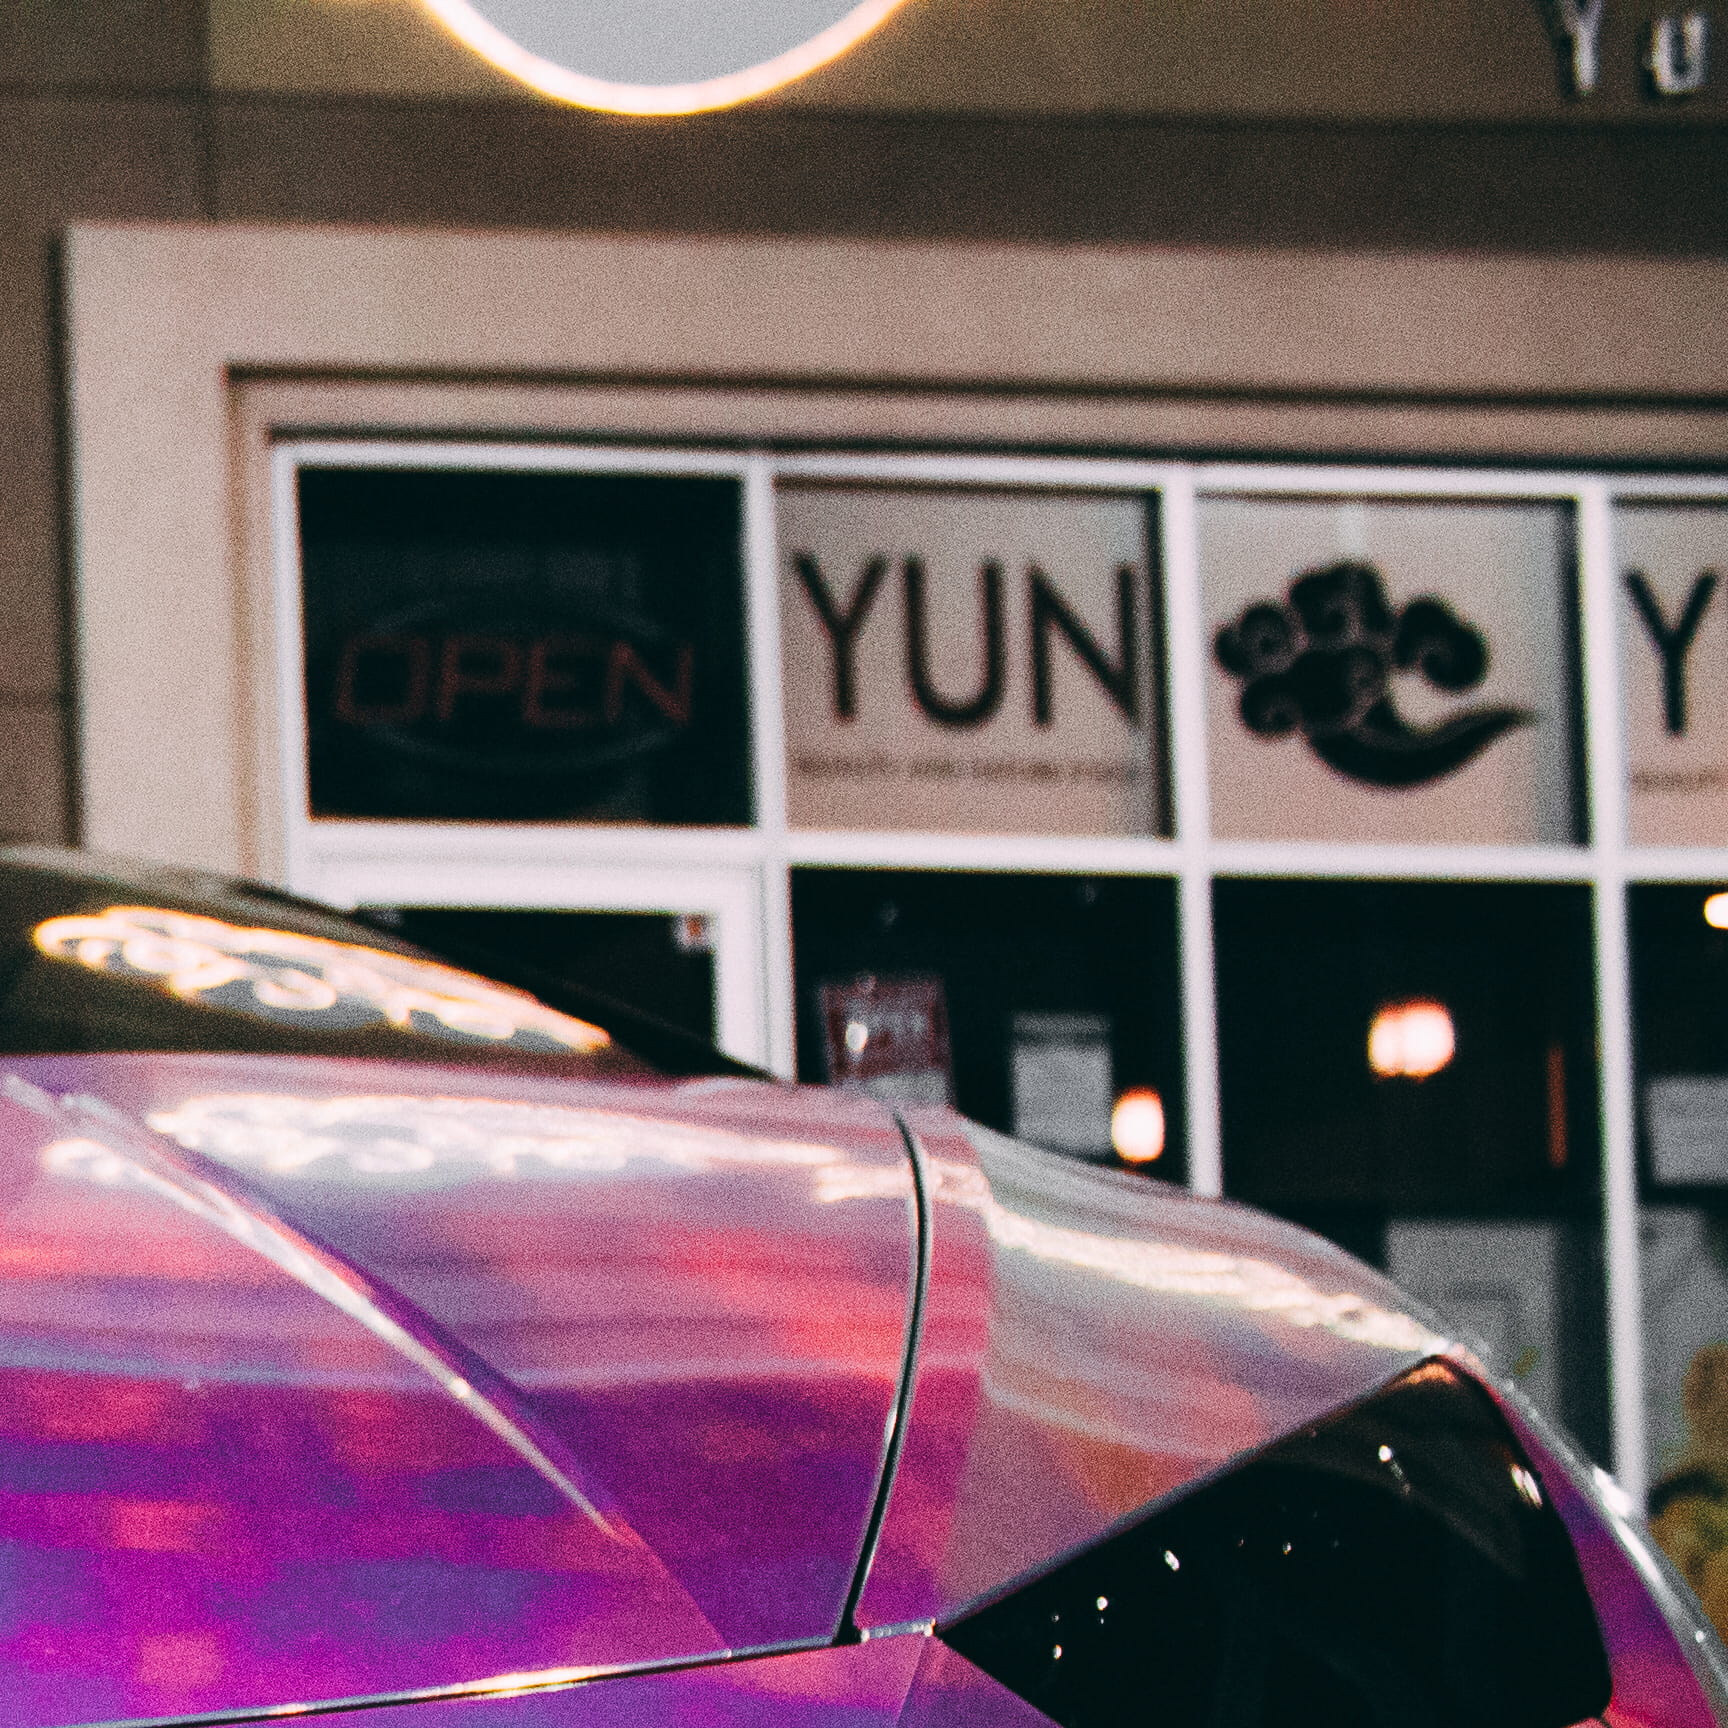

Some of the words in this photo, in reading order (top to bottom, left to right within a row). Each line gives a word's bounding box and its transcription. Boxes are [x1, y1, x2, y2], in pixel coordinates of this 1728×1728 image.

[334, 631, 694, 728] OPEN
[792, 551, 1141, 730] YUN
[1624, 569, 1720, 735] Y
